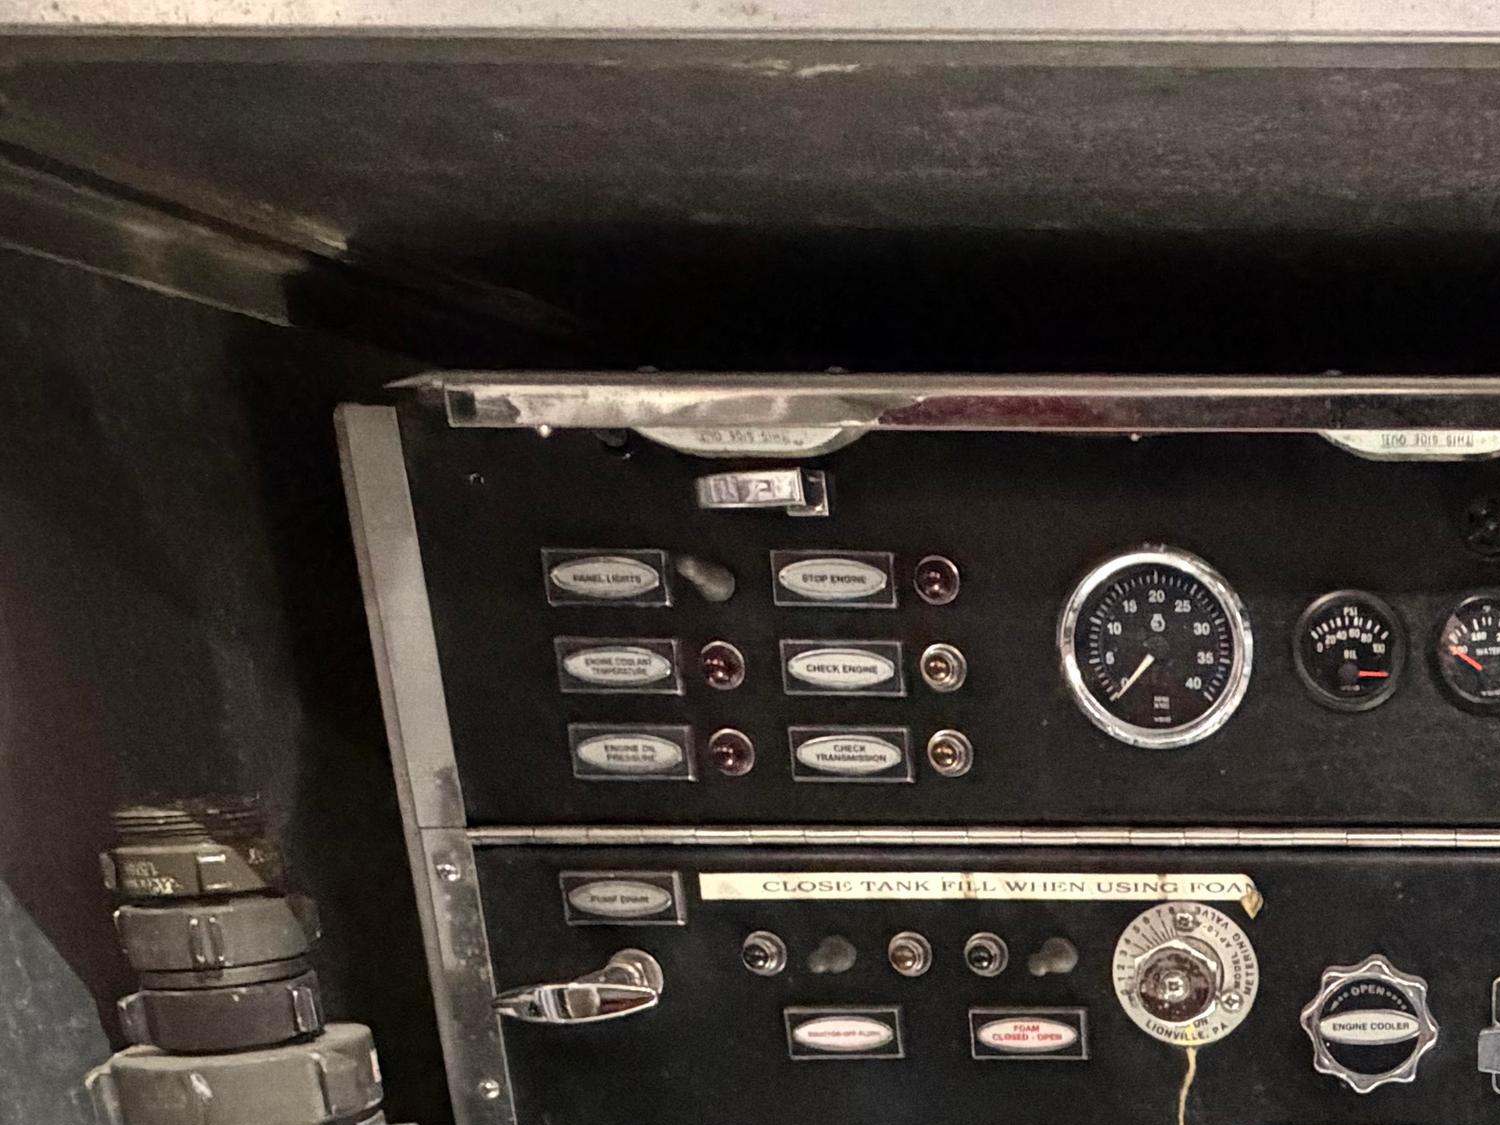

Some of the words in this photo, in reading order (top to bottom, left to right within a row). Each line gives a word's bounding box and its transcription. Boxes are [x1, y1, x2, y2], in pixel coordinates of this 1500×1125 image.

[1148, 590, 1165, 602] 20
[1122, 601, 1137, 613] 15
[1175, 600, 1191, 612] 25
[1107, 622, 1122, 635] 10
[1194, 622, 1210, 635] 30
[1106, 652, 1115, 665] 5
[1197, 652, 1214, 664] 35
[806, 664, 840, 673] CHECK
[842, 665, 878, 674] ENGINE
[1185, 677, 1201, 690] 40
[816, 754, 887, 762] TRANSMISSION
[762, 880, 852, 892] CLOSE
[862, 880, 930, 892] TANK
[942, 881, 996, 892] FILL
[1005, 881, 1085, 893] WHEN
[1097, 881, 1179, 893] USING
[1232, 933, 1255, 995] METERING
[1232, 952, 1241, 989] MODEL
[1351, 984, 1385, 996] OPEN
[1212, 1022, 1229, 1035] PA
[1333, 1023, 1368, 1031] ENGINE
[1370, 1022, 1410, 1031] COOLER
[992, 1033, 1028, 1041] CLOSED
[1037, 1033, 1062, 1041] OPEN
